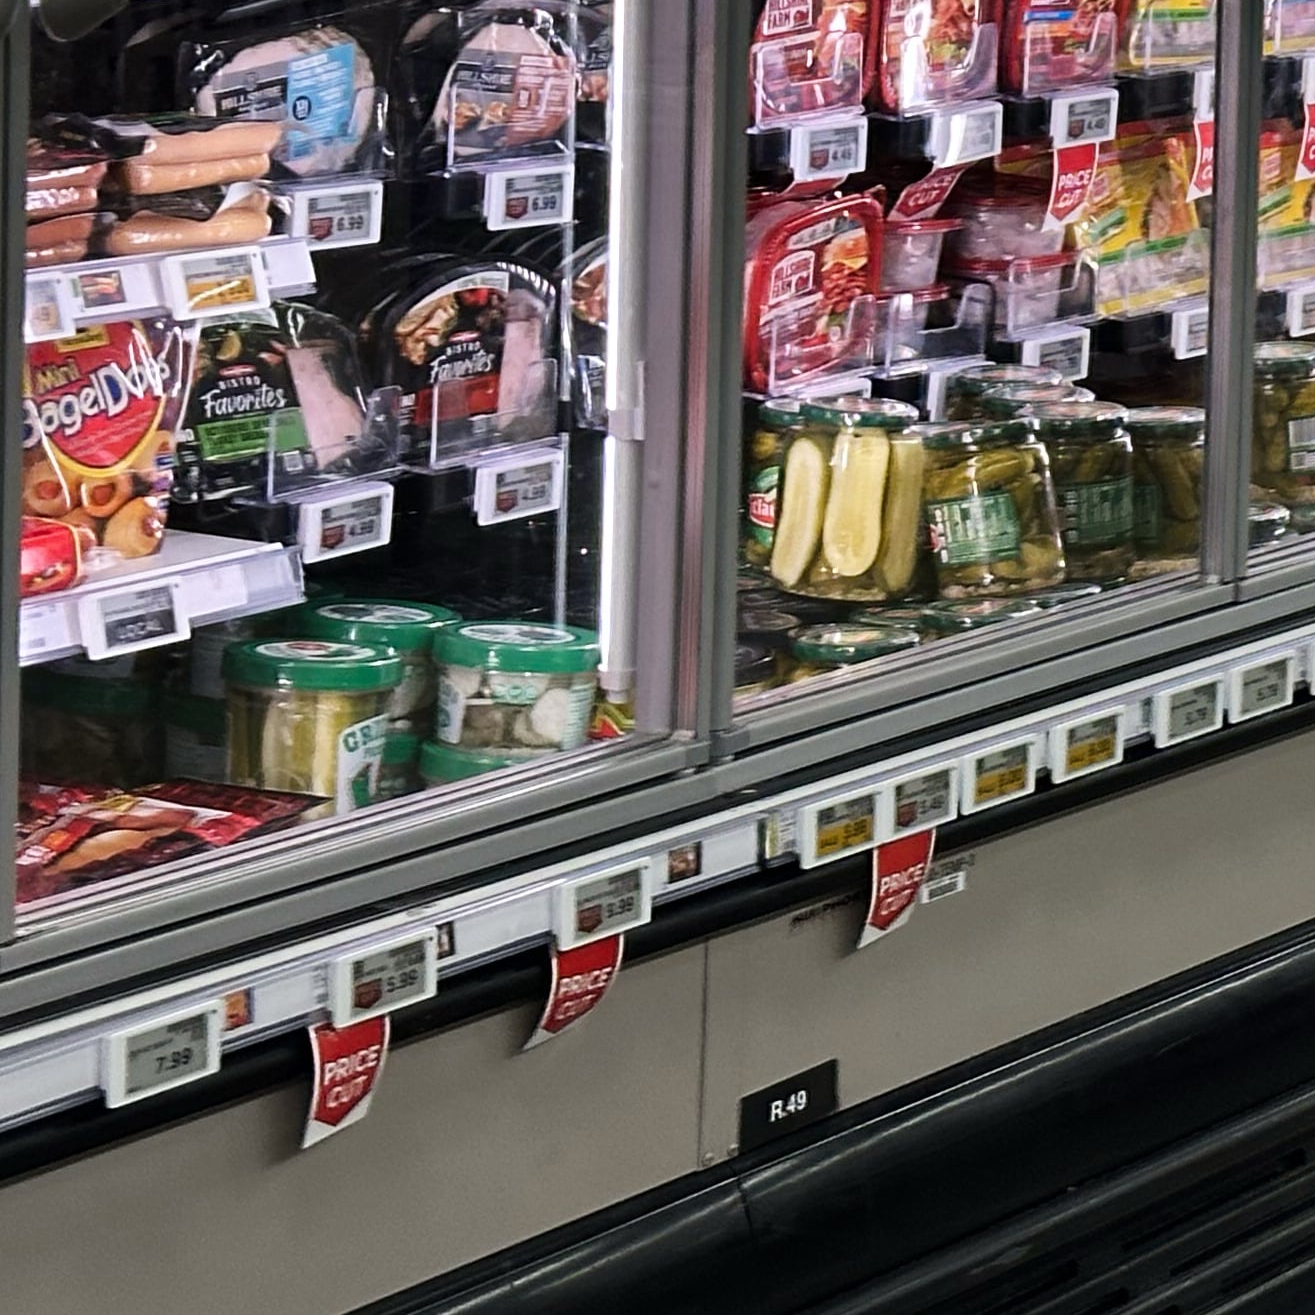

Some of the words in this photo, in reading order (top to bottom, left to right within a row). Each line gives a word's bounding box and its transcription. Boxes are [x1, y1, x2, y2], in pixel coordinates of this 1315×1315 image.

[767, 10, 791, 30] FARM
[1057, 170, 1092, 188] PRICE
[531, 194, 558, 212] 6.99
[908, 189, 940, 207] CUT
[1055, 189, 1086, 209] CUT
[336, 216, 365, 232] 6.99
[446, 340, 481, 357] BISTRO
[429, 350, 496, 384] Favorites
[217, 375, 262, 391] BISTRO
[199, 384, 288, 419] Favorites
[880, 863, 925, 896] PRICE
[879, 889, 916, 917] CUT
[558, 967, 613, 998] PRICE
[556, 989, 598, 1021] CUT
[154, 1046, 195, 1074] 7.99
[323, 1044, 381, 1085] PRICE
[325, 1075, 368, 1110] CUT
[769, 1089, 807, 1123] R.49
